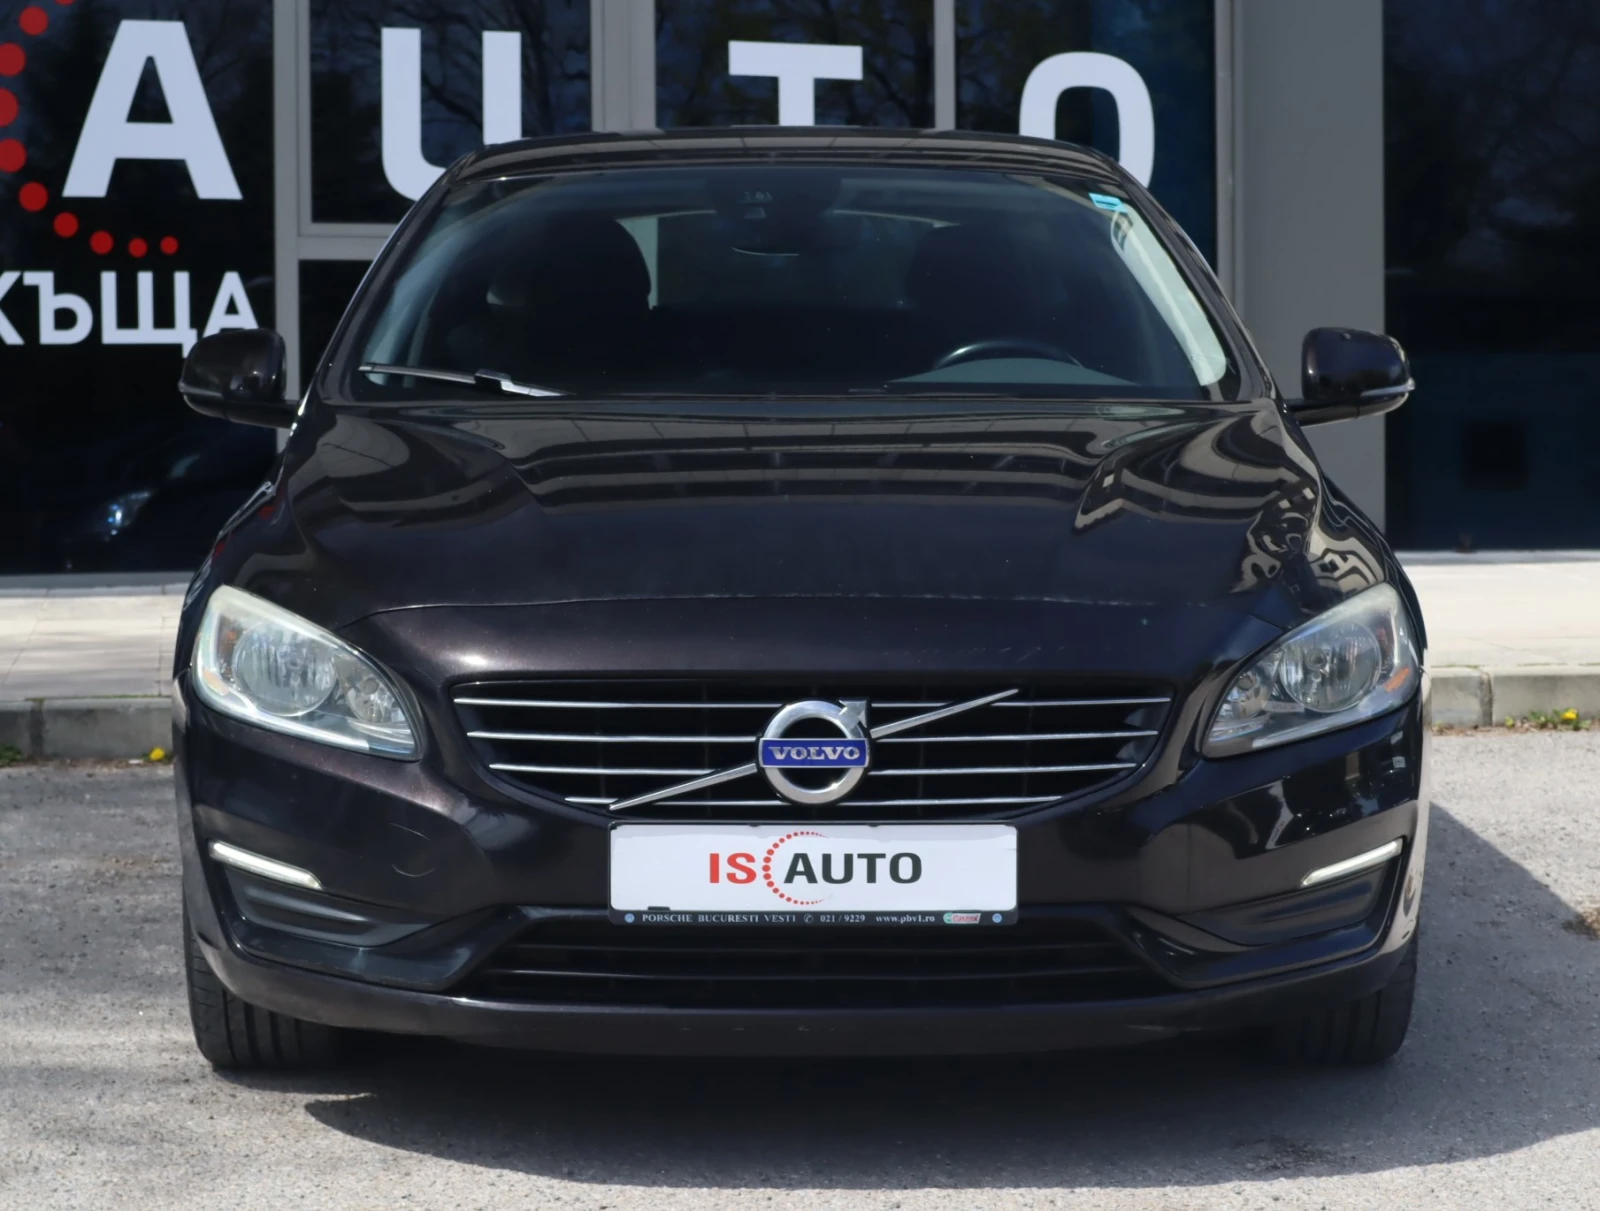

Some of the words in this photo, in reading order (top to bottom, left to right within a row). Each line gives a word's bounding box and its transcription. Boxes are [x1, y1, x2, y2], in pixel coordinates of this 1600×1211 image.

[768, 746, 861, 760] VOLVO
[709, 852, 758, 884] IS
[783, 852, 922, 884] AUTO
[642, 914, 693, 923] PORSCHE
[698, 914, 759, 923] BUCURESTI
[819, 914, 835, 923] 021
[844, 914, 866, 923] 9229
